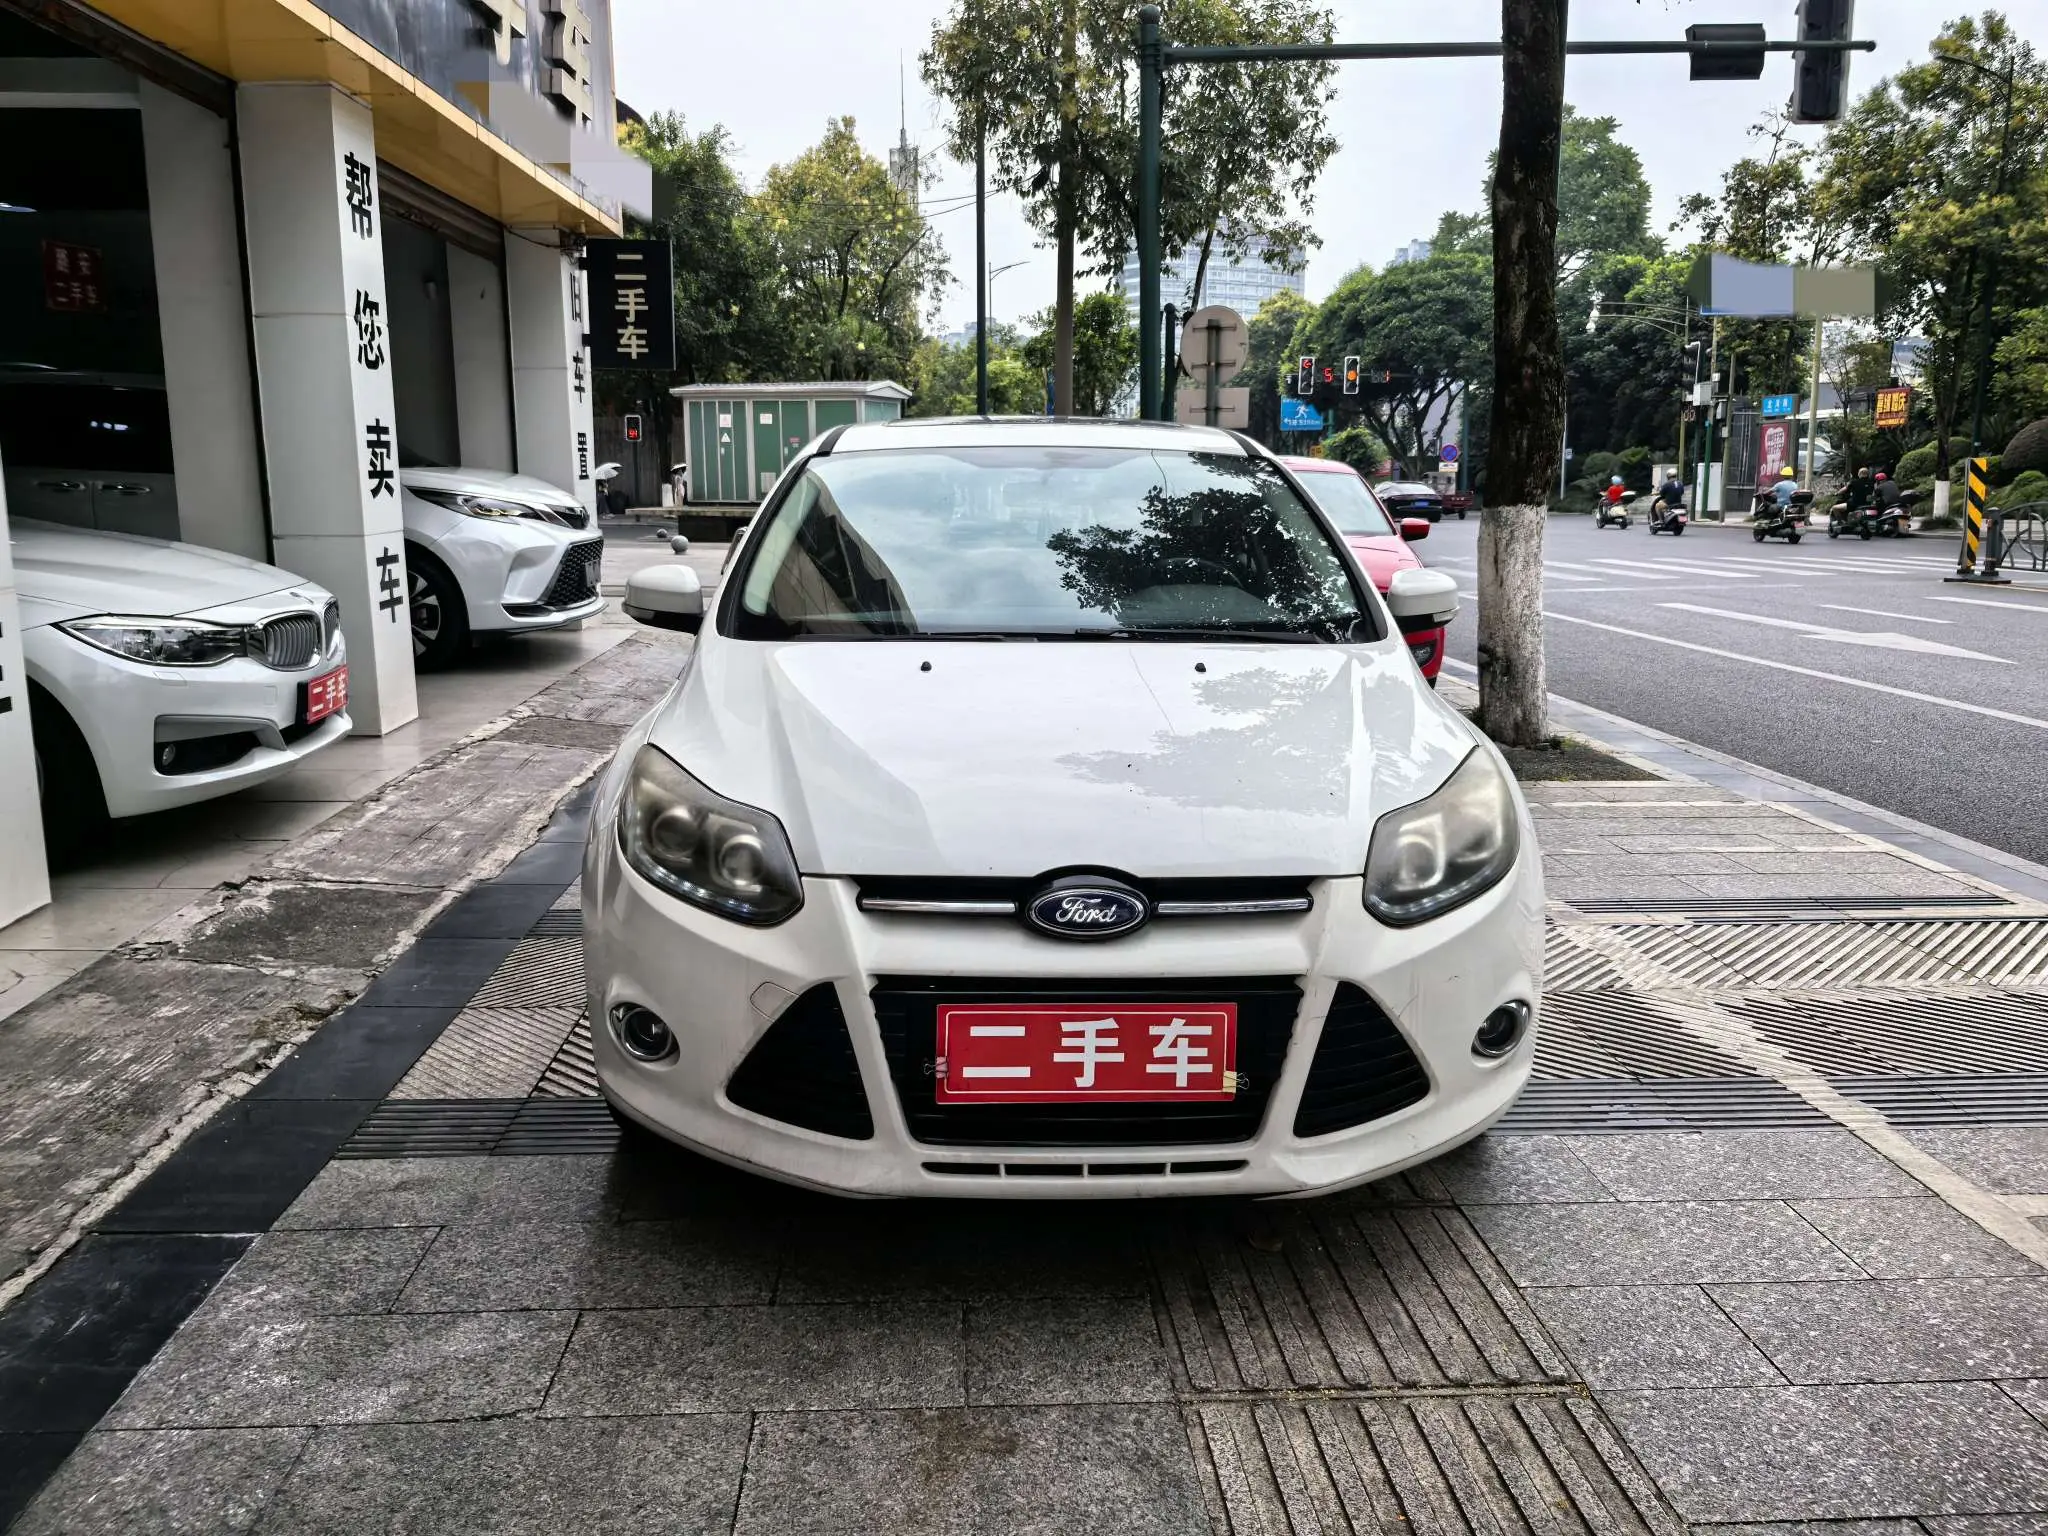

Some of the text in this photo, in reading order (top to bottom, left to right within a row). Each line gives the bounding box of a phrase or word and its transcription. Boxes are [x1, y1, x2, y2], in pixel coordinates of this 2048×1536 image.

[614, 254, 649, 360] 二手车
[345, 151, 404, 623] 帮您卖车
[312, 672, 346, 713] 二手车
[1056, 897, 1118, 922] Ford
[963, 1017, 1213, 1087] 二手车
